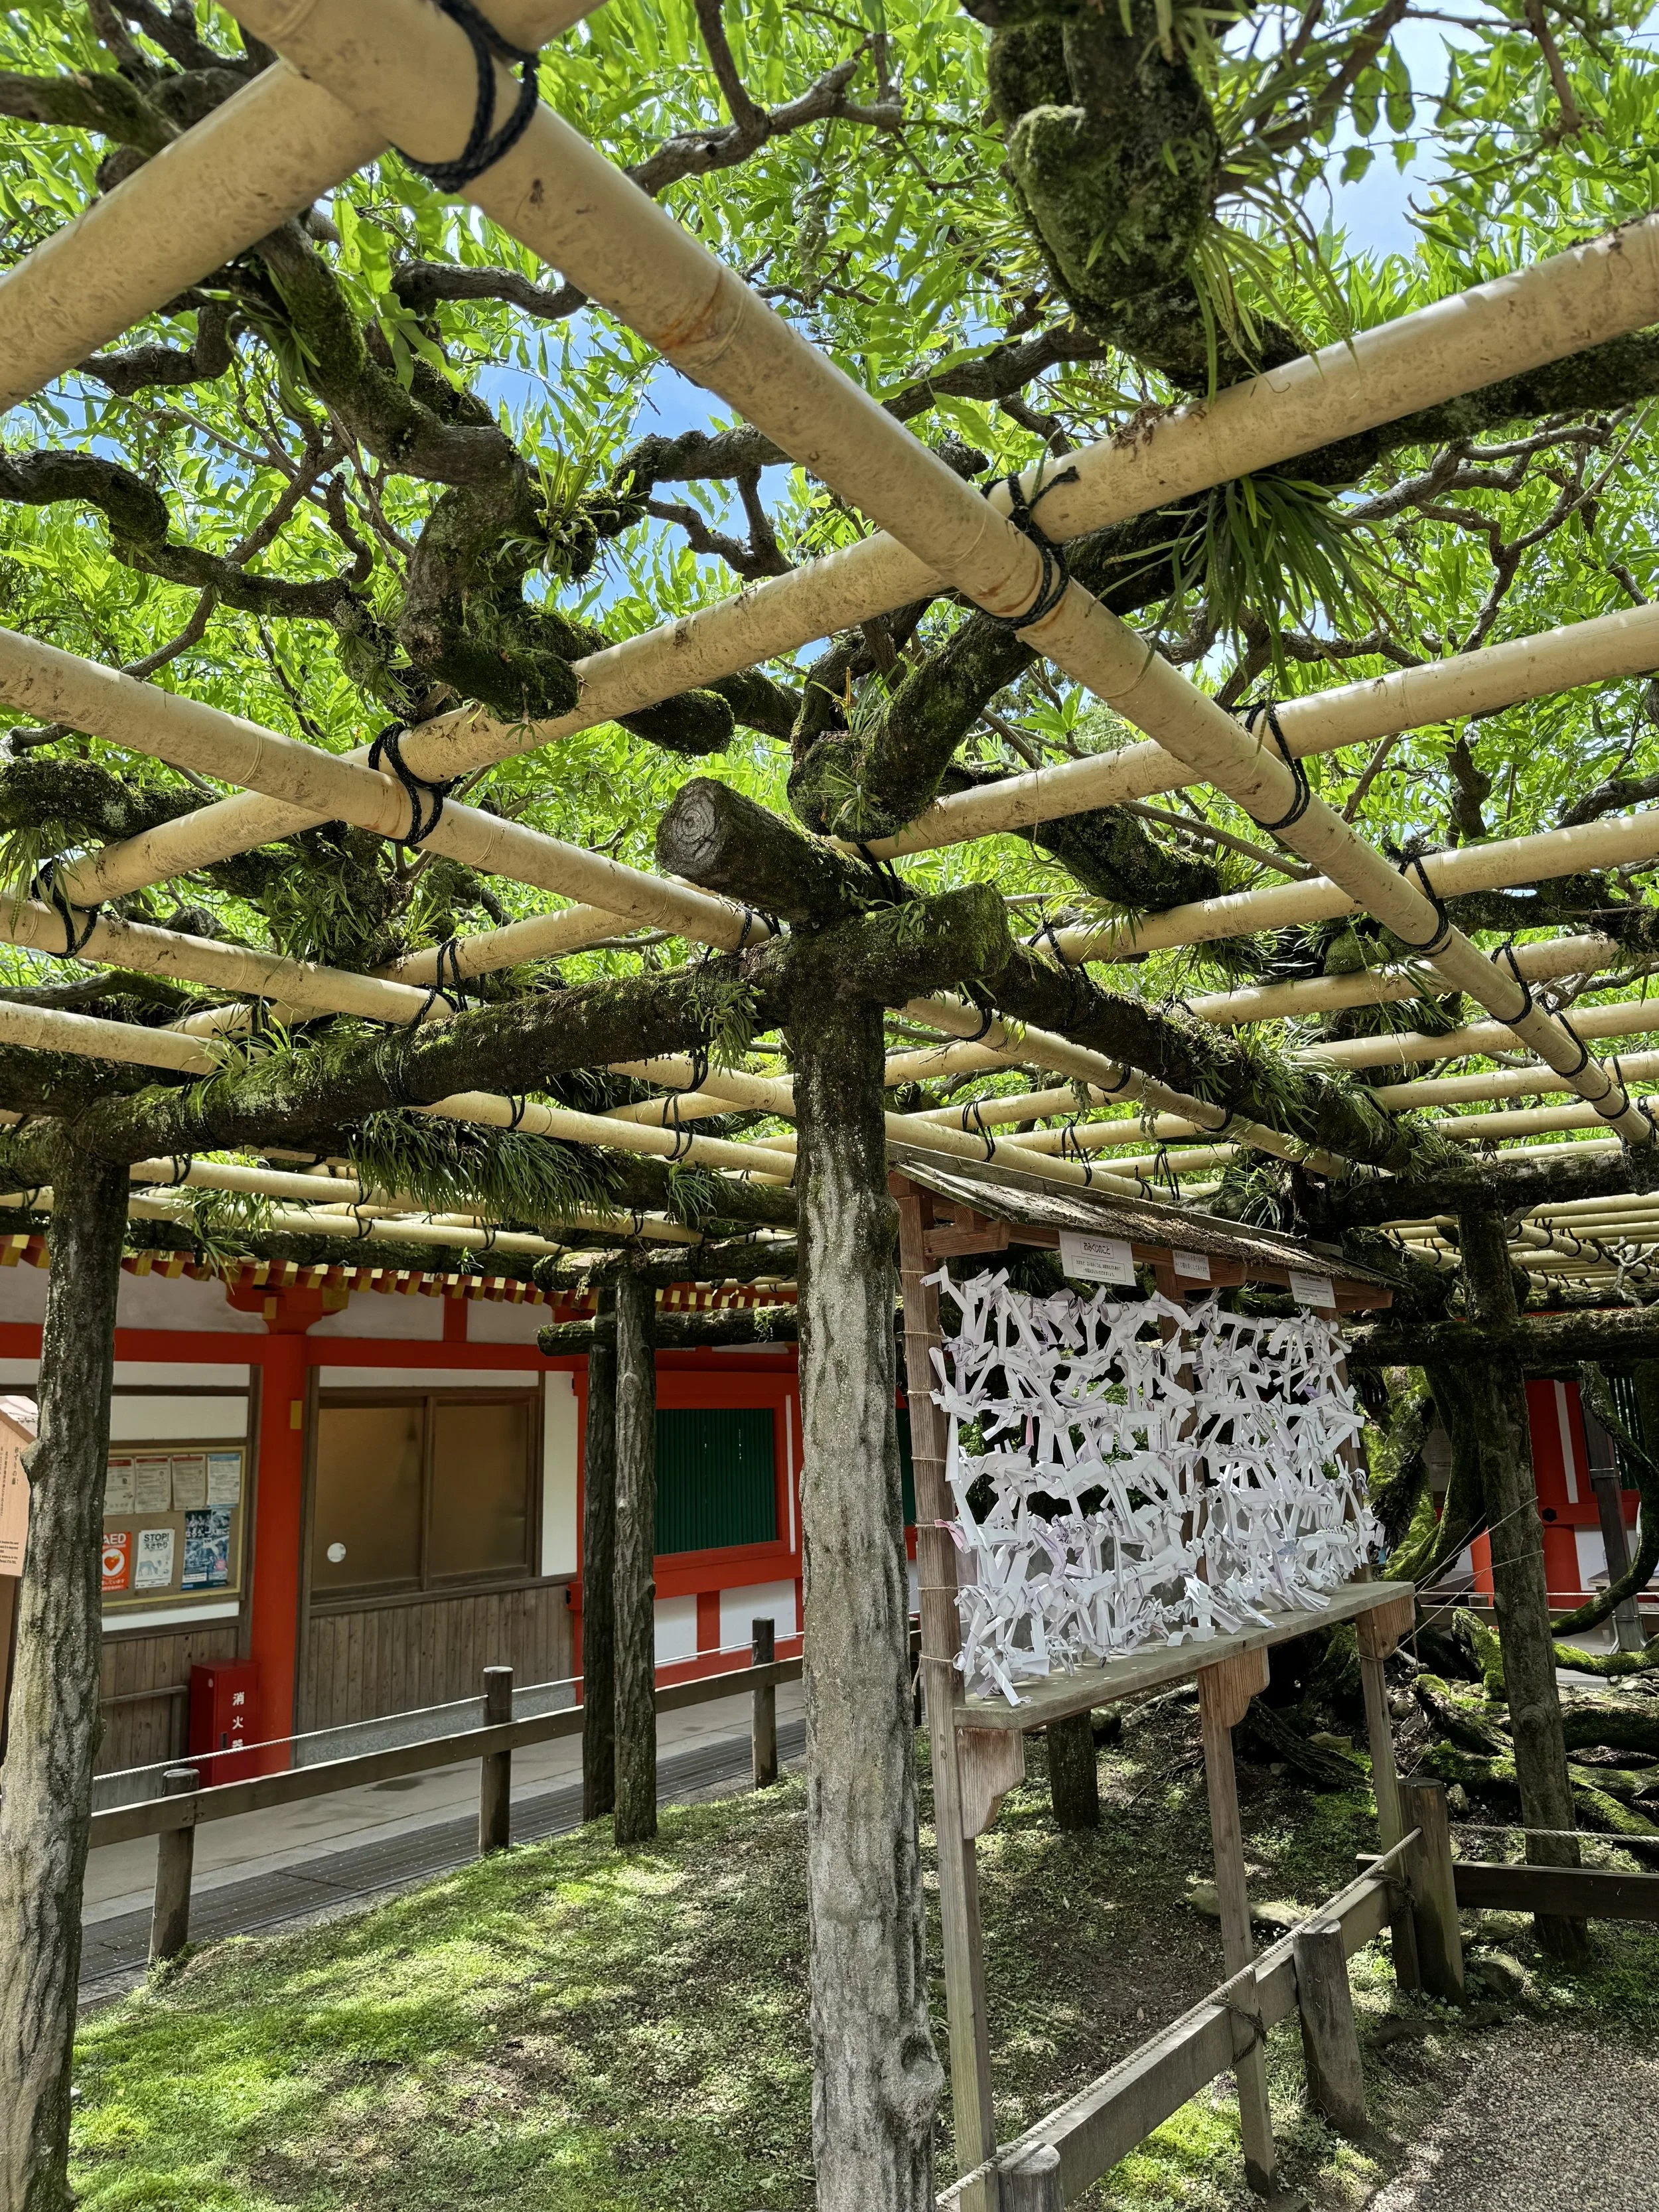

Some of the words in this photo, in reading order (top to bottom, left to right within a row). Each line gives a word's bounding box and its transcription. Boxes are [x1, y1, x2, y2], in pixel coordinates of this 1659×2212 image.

[1083, 1242, 1111, 1255] おみくじのこと
[104, 1533, 127, 1544] AED
[144, 1532, 169, 1542] STOP!
